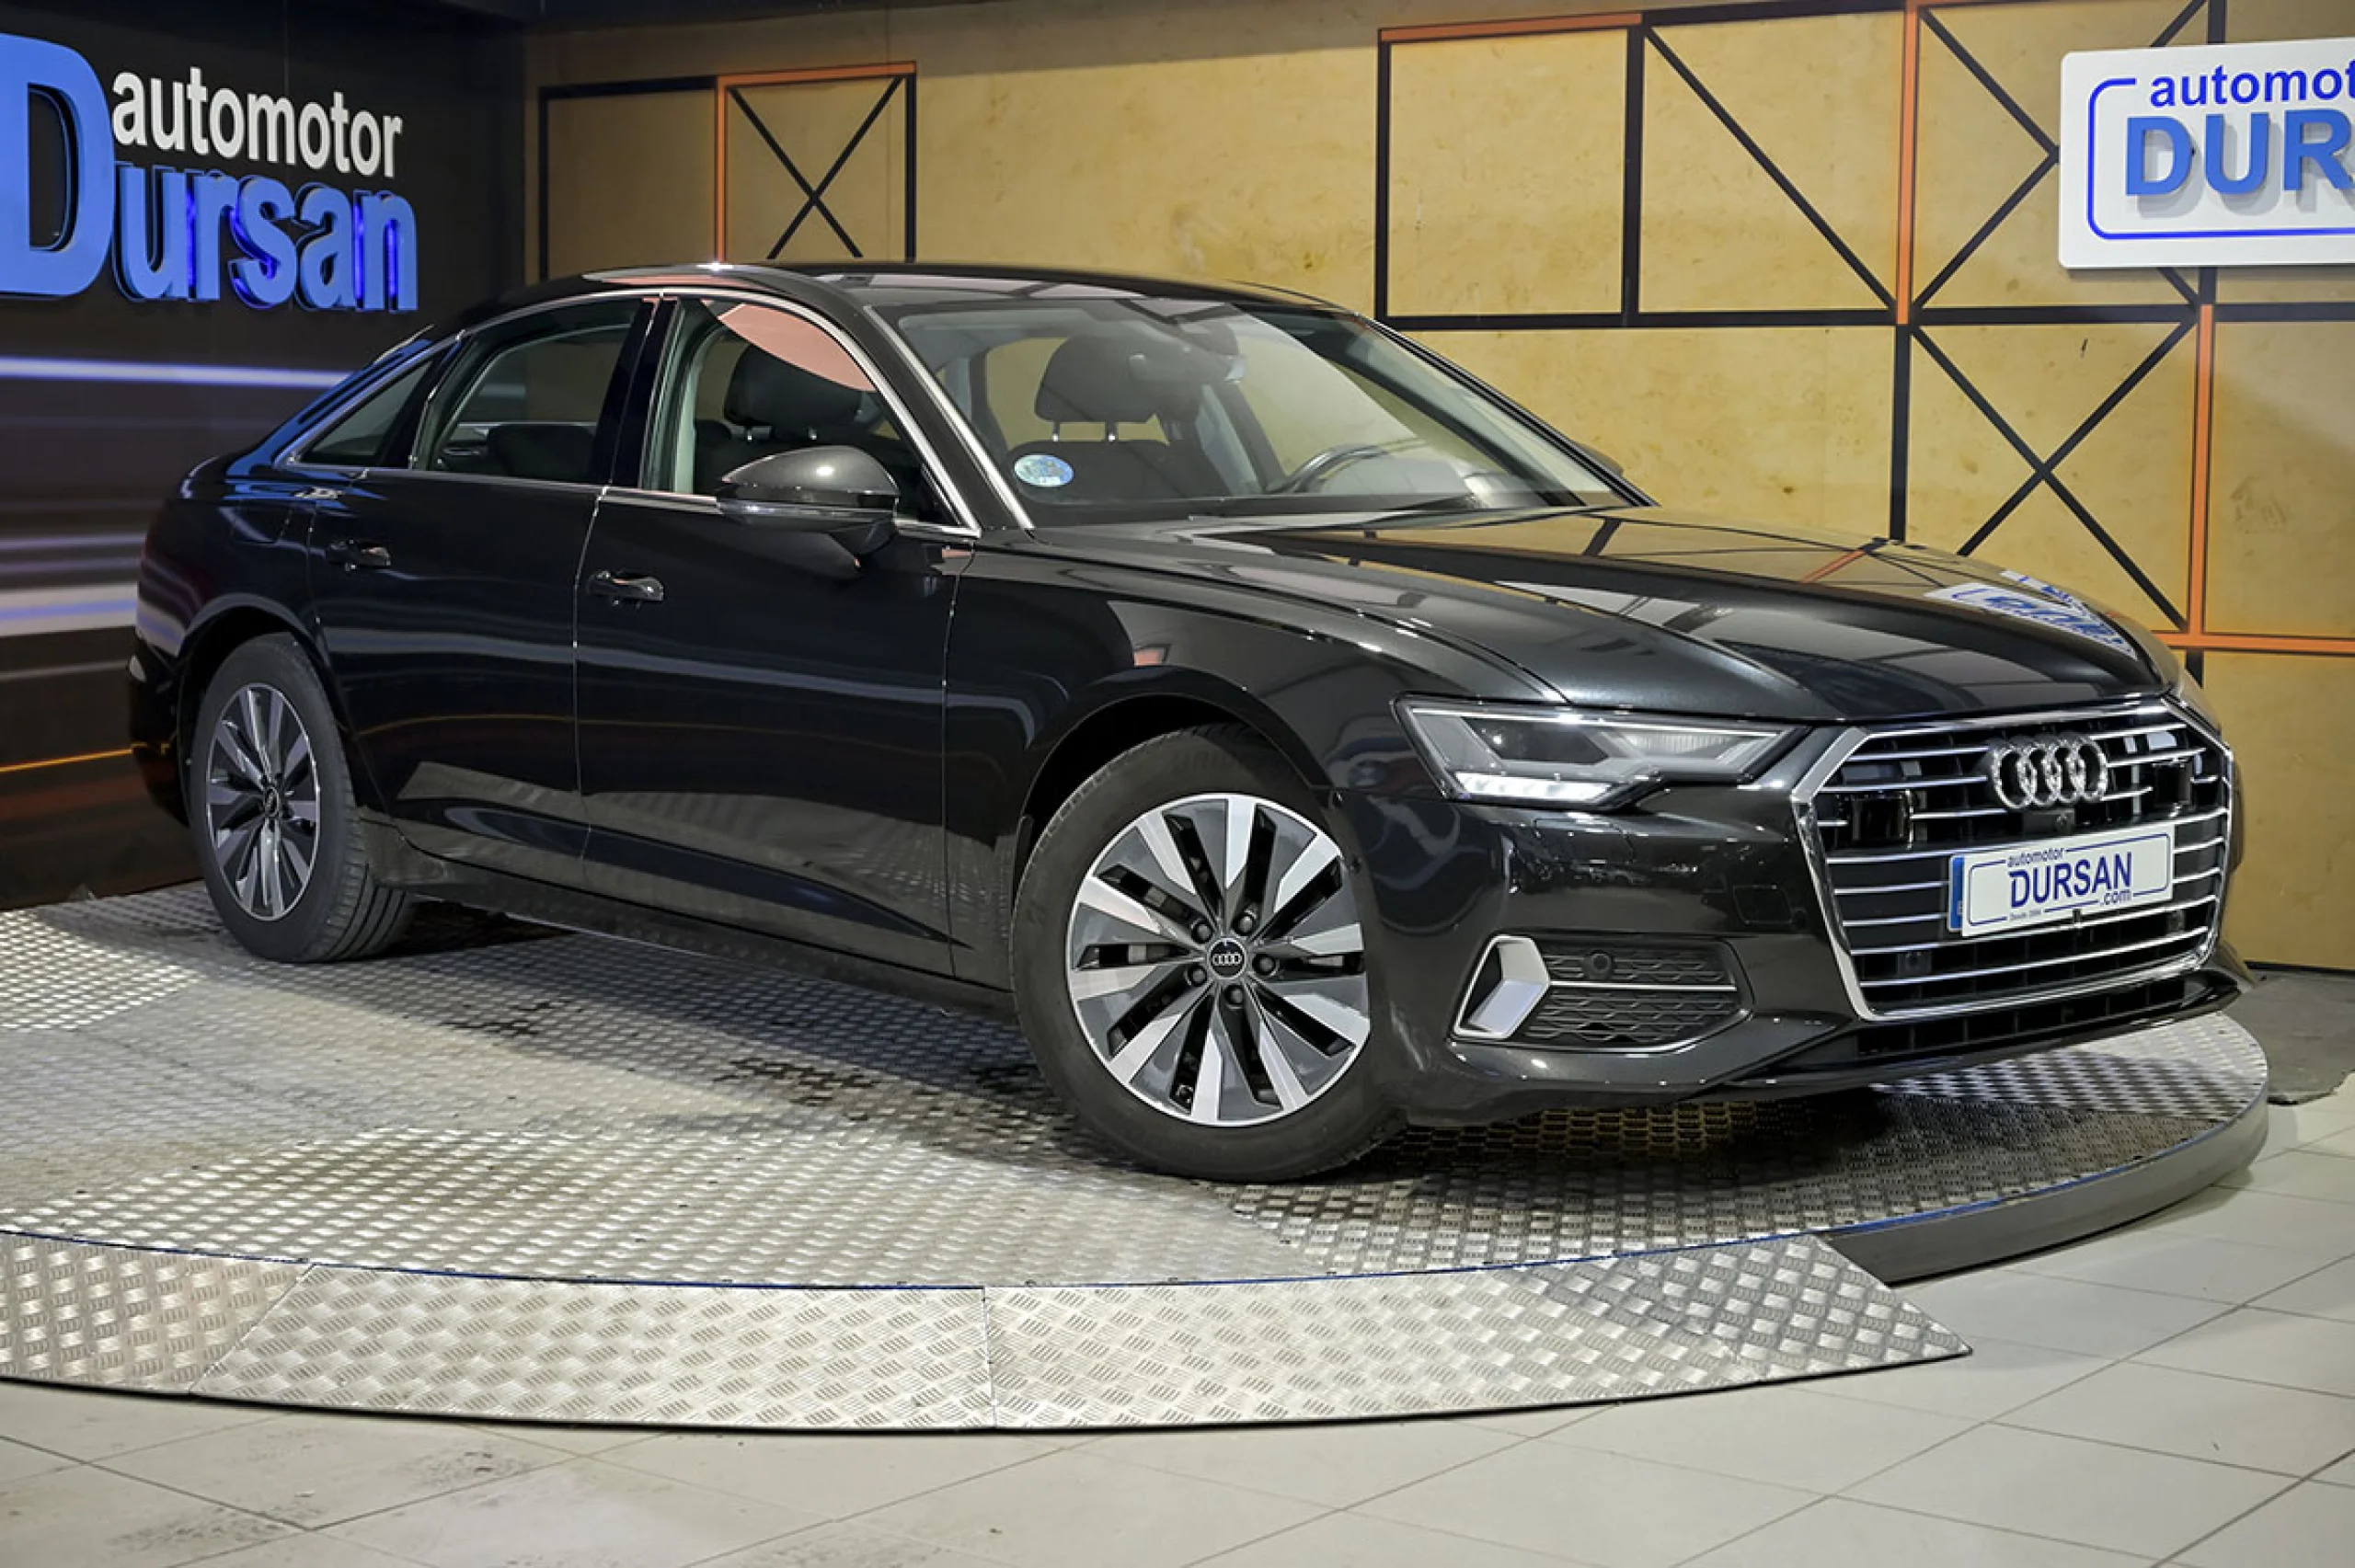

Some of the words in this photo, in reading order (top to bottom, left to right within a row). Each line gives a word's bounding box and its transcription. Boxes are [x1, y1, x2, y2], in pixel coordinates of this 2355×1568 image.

[111, 66, 403, 177] automotor
[0, 33, 419, 311] Dursan
[2007, 848, 2064, 867] automotor
[2008, 852, 2132, 909] DURSAN
[2099, 888, 2131, 906] .com
